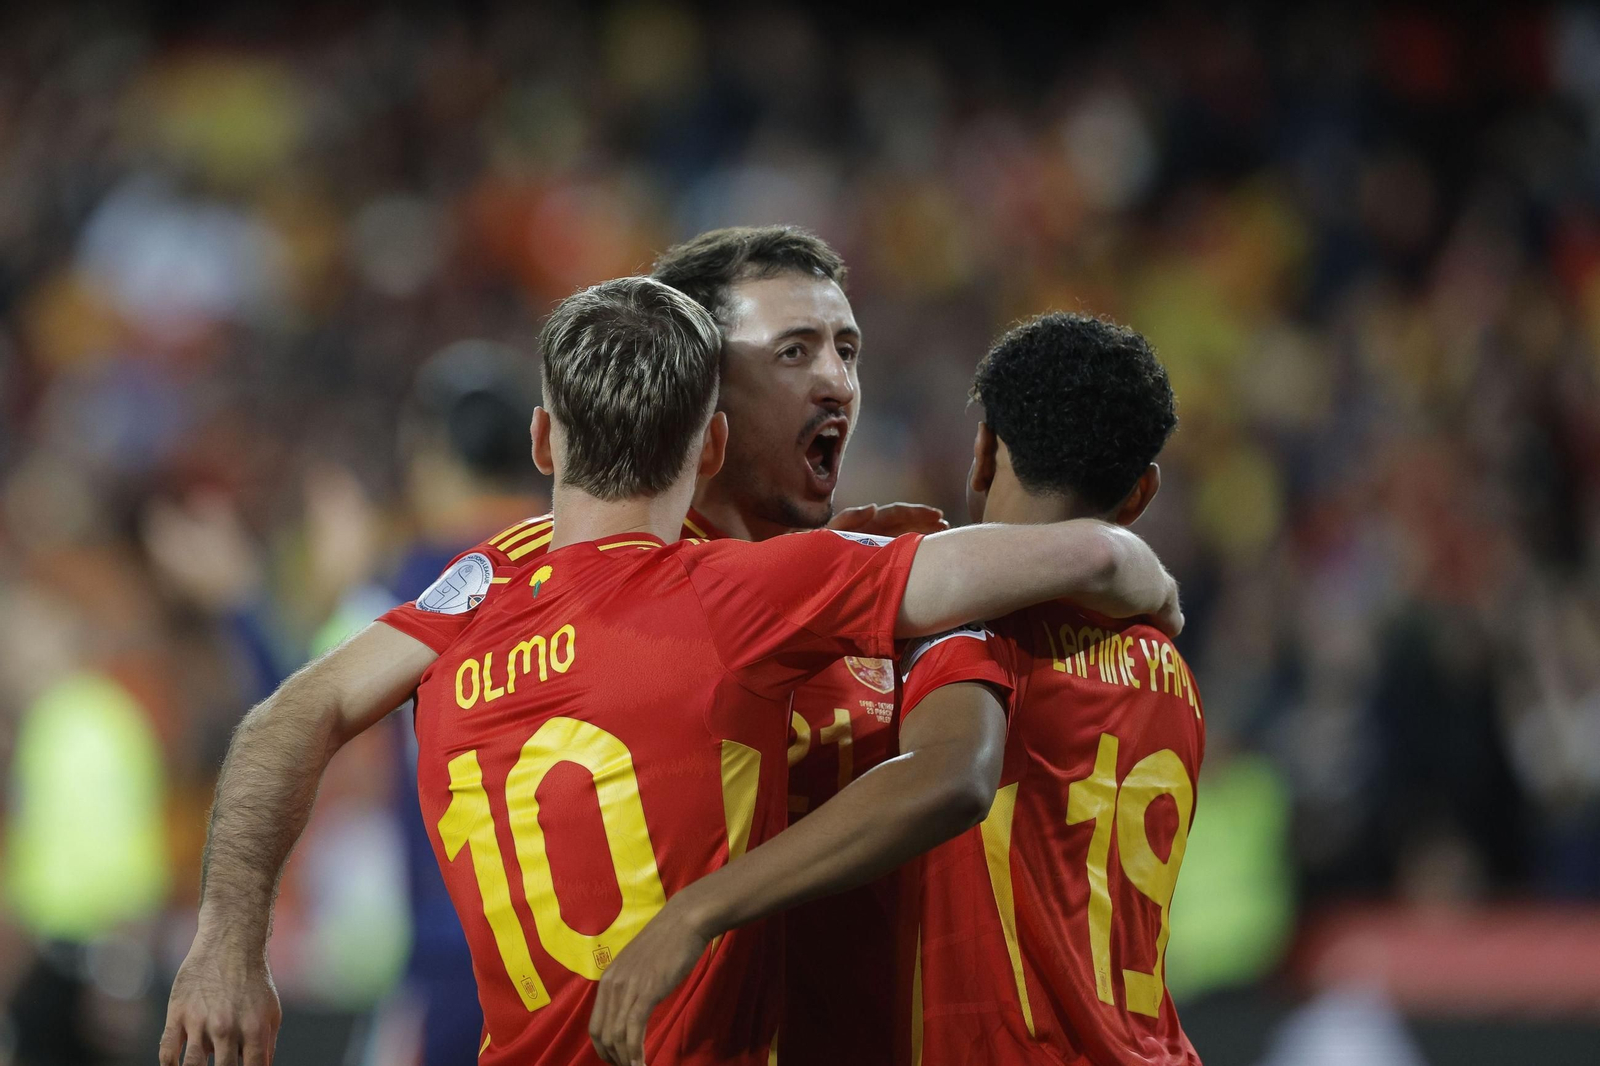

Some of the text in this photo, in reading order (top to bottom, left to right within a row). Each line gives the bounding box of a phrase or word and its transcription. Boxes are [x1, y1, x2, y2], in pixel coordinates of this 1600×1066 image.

[482, 563, 490, 584] LEAGUE
[455, 623, 576, 710] OLMO
[1042, 620, 1141, 689] LAMINE
[437, 716, 667, 1012] 10
[1066, 733, 1193, 1018] 19
